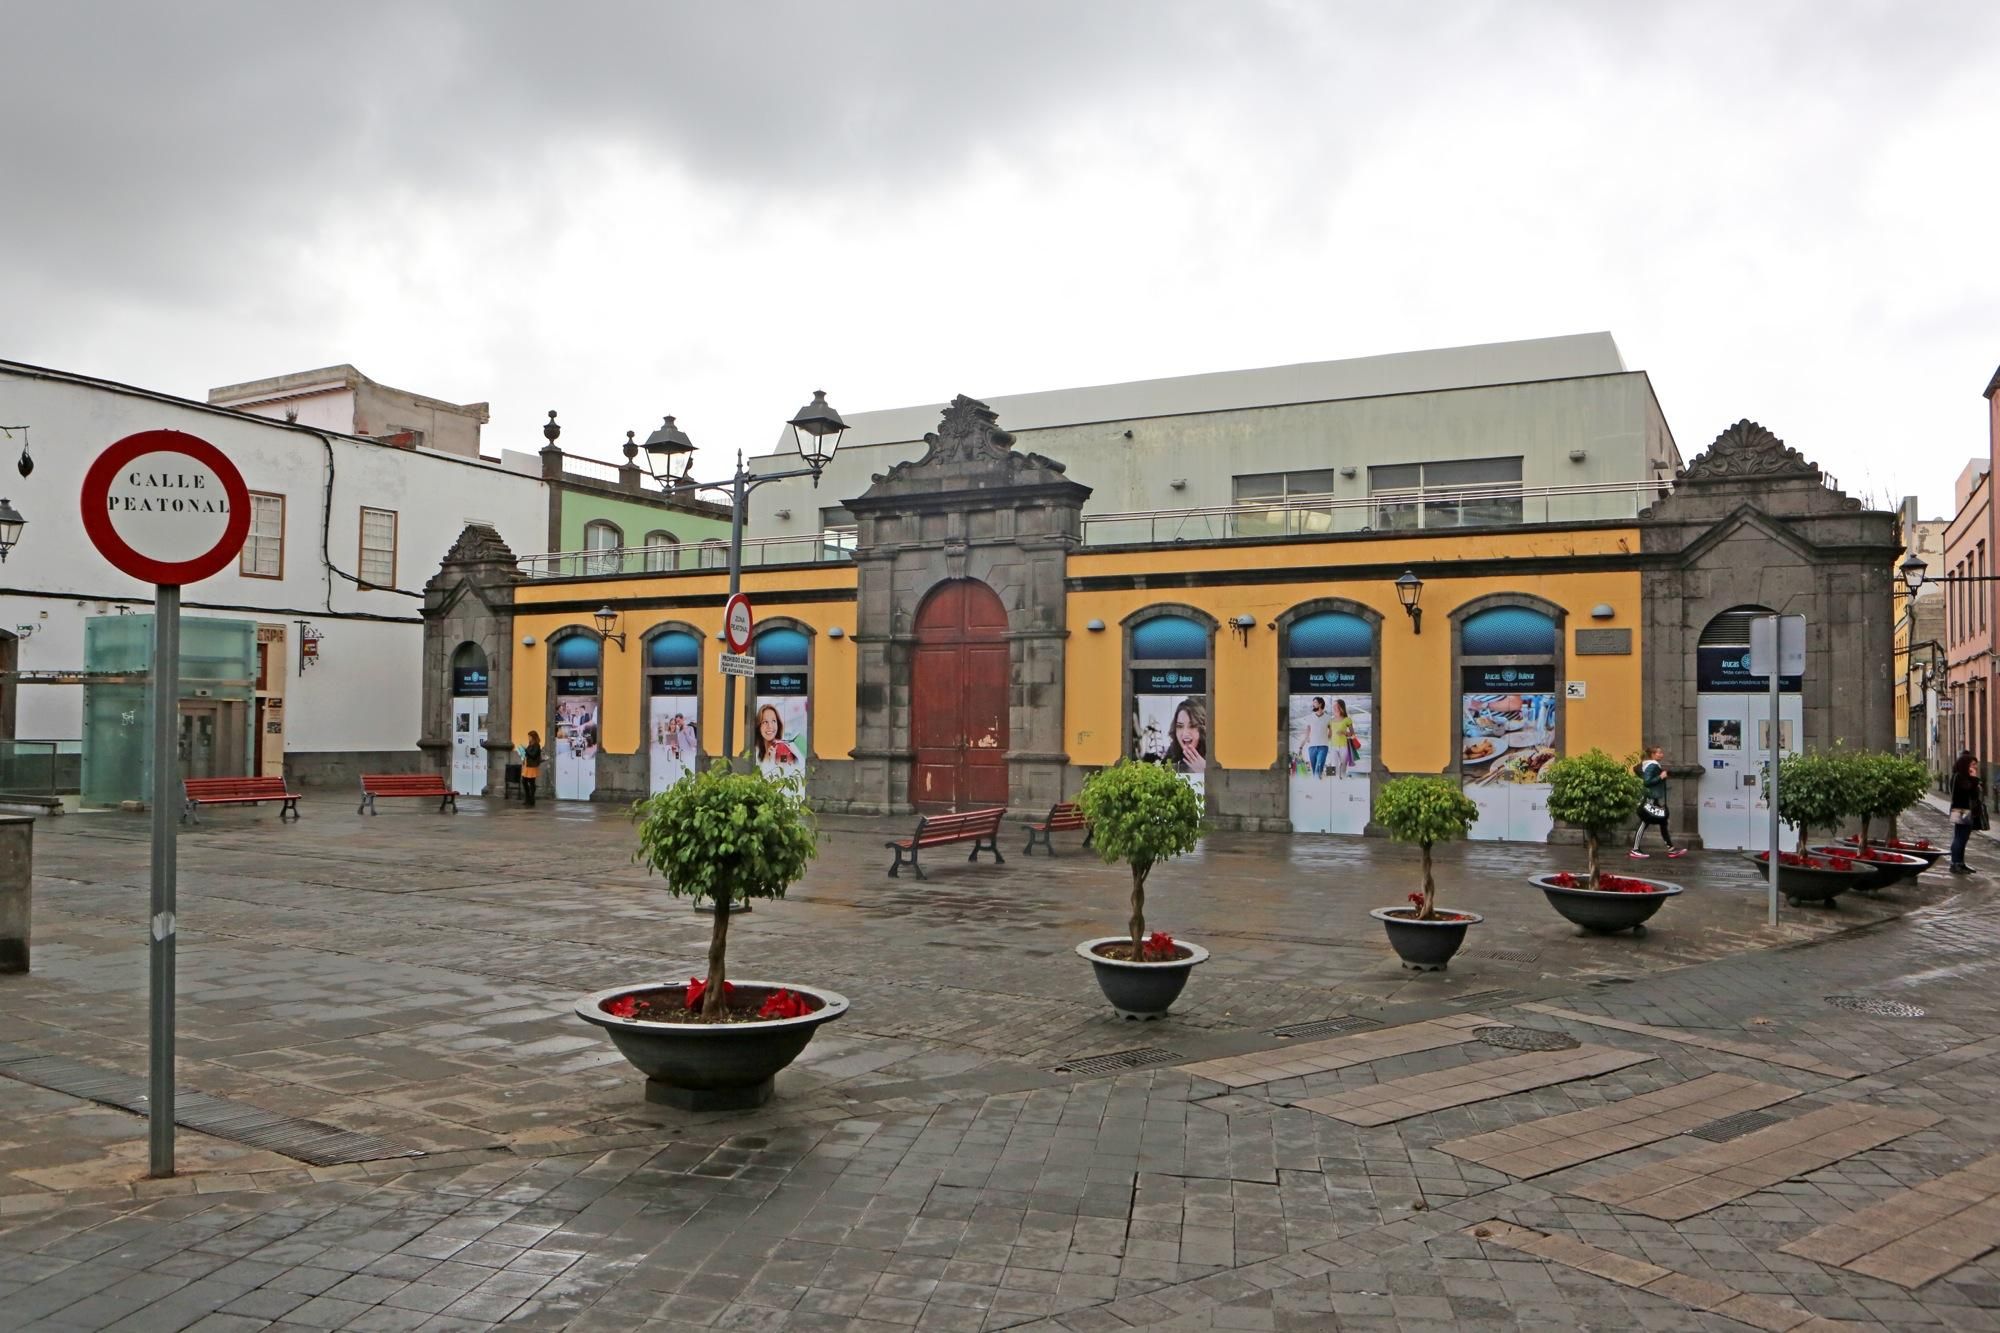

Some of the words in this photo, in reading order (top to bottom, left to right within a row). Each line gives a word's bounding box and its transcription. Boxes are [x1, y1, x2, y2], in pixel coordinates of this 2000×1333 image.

[129, 472, 205, 488] CALLE
[108, 496, 230, 513] PEATONAL
[730, 624, 748, 633] PEATONAL
[1722, 660, 1740, 668] Arucas
